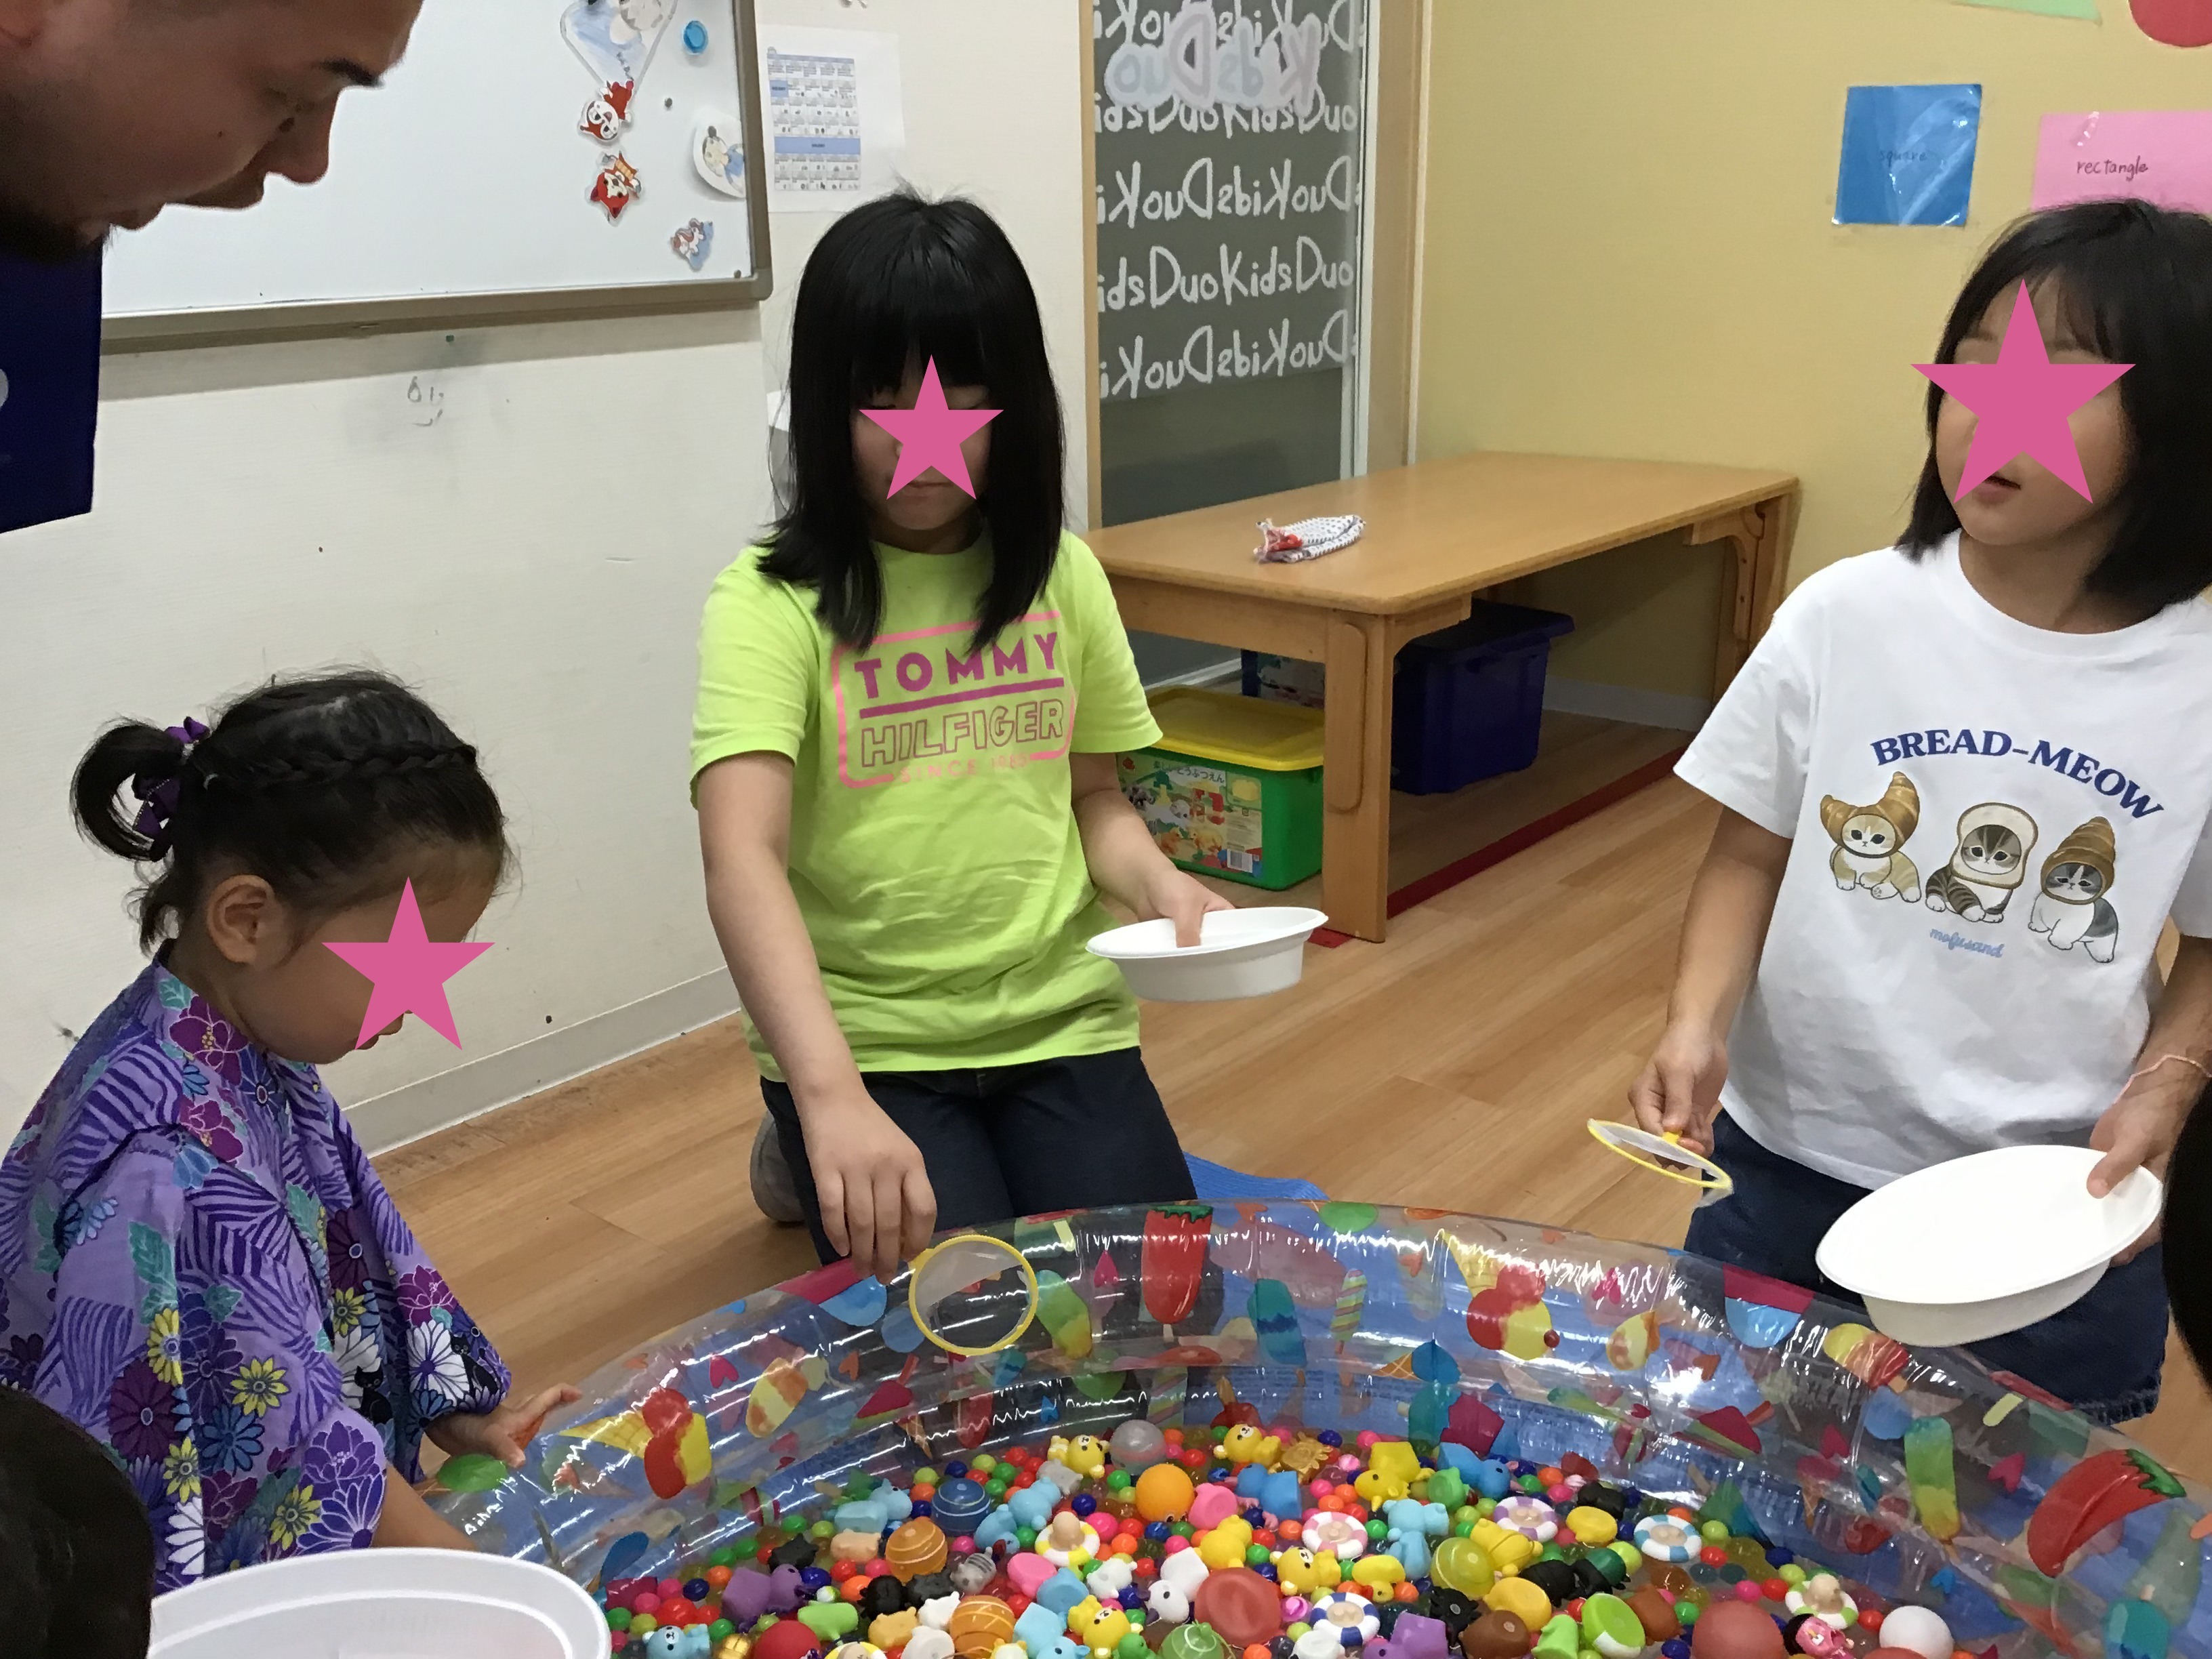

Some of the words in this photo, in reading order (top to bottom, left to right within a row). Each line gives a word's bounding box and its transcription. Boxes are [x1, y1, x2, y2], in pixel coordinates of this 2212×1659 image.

[2076, 156, 2149, 182] rectangle
[854, 632, 1058, 699] TOMMY
[861, 698, 1065, 768] HILFIGER
[1870, 729, 2164, 819] BREAD-MEOW
